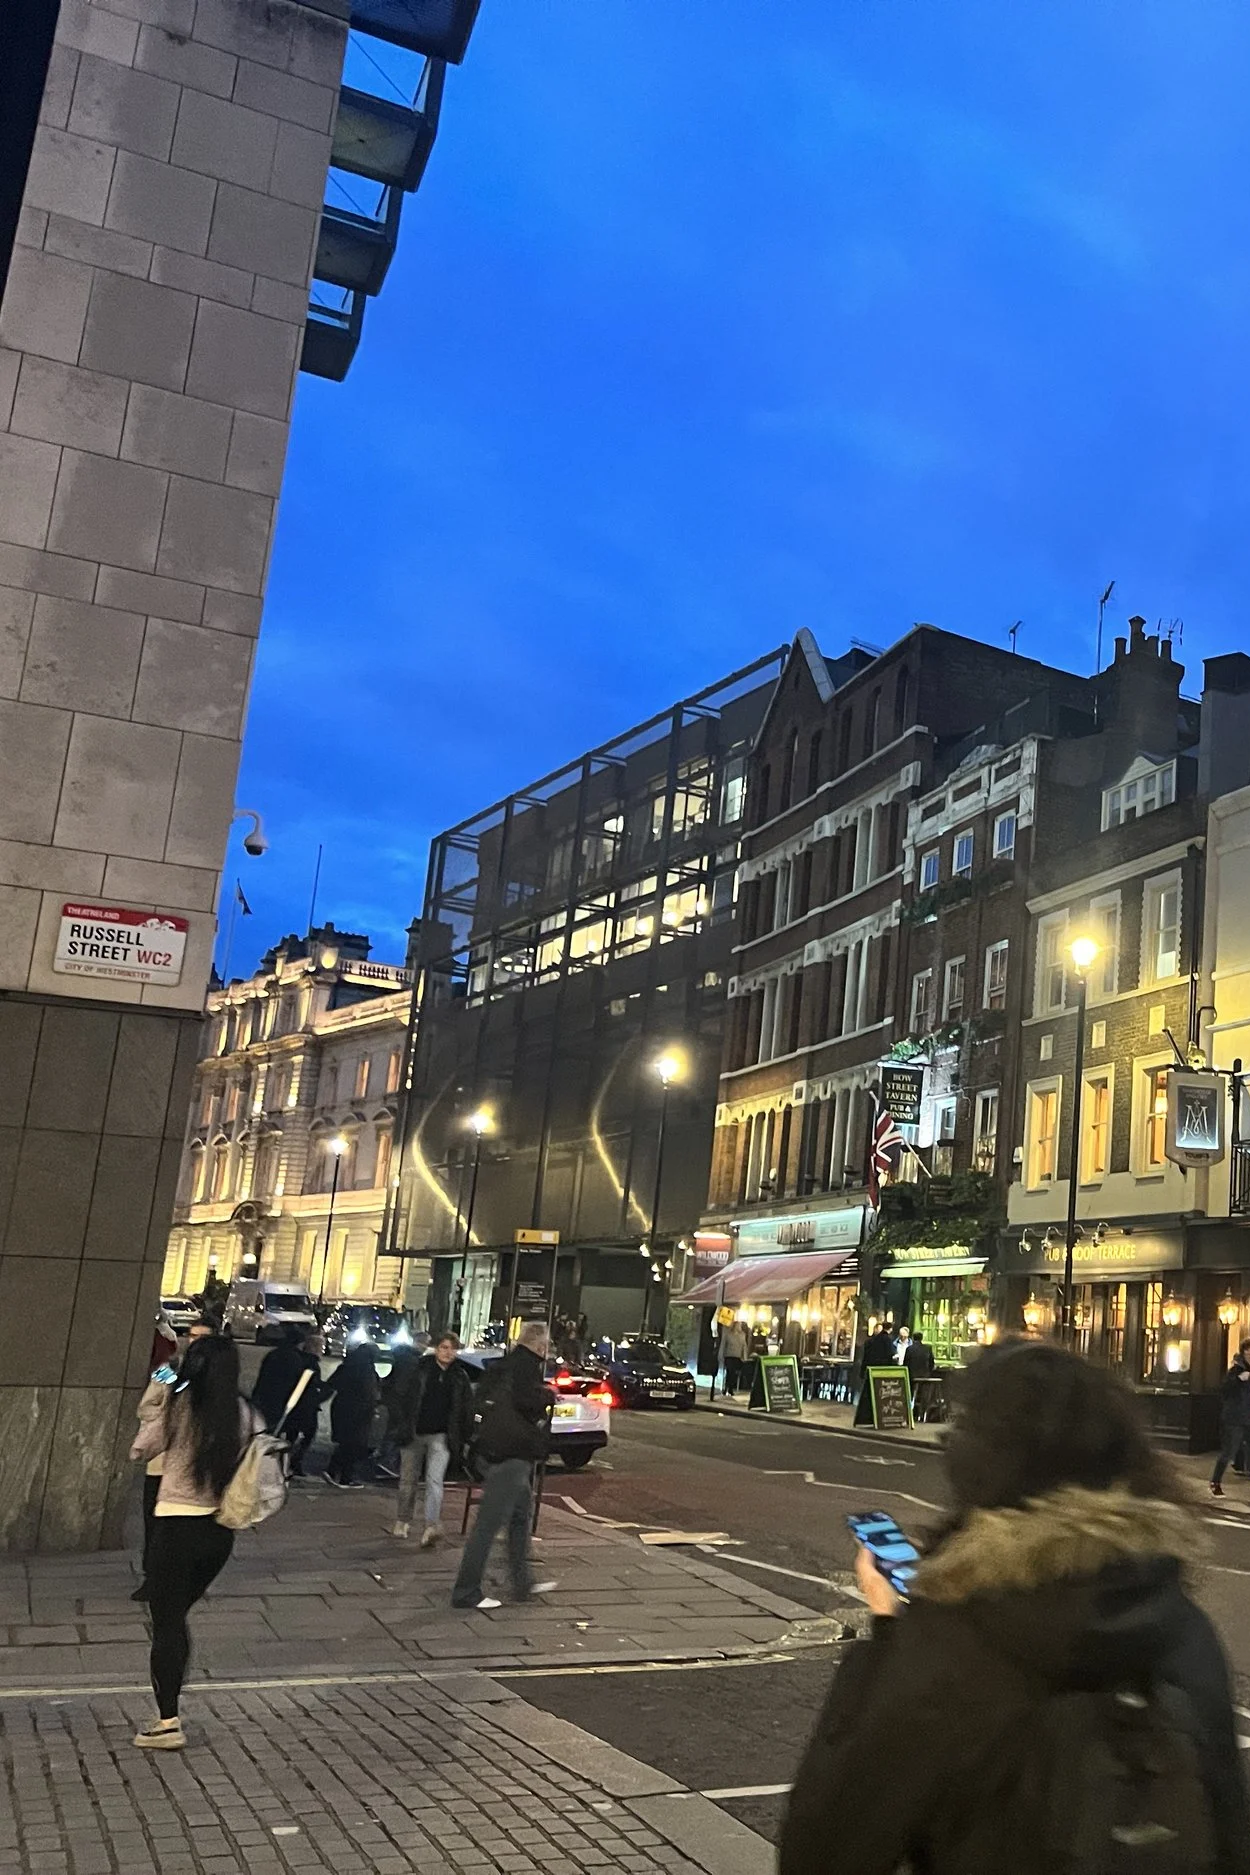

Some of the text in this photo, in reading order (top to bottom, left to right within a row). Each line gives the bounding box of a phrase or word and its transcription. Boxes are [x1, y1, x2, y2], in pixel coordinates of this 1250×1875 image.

[70, 924, 145, 946] RUSSELL
[68, 941, 173, 967] STREET WC2
[886, 1082, 918, 1092] STREET
[885, 1092, 918, 1102] TAVERN
[889, 1111, 914, 1120] INING
[1098, 1243, 1136, 1260] TERRACE
